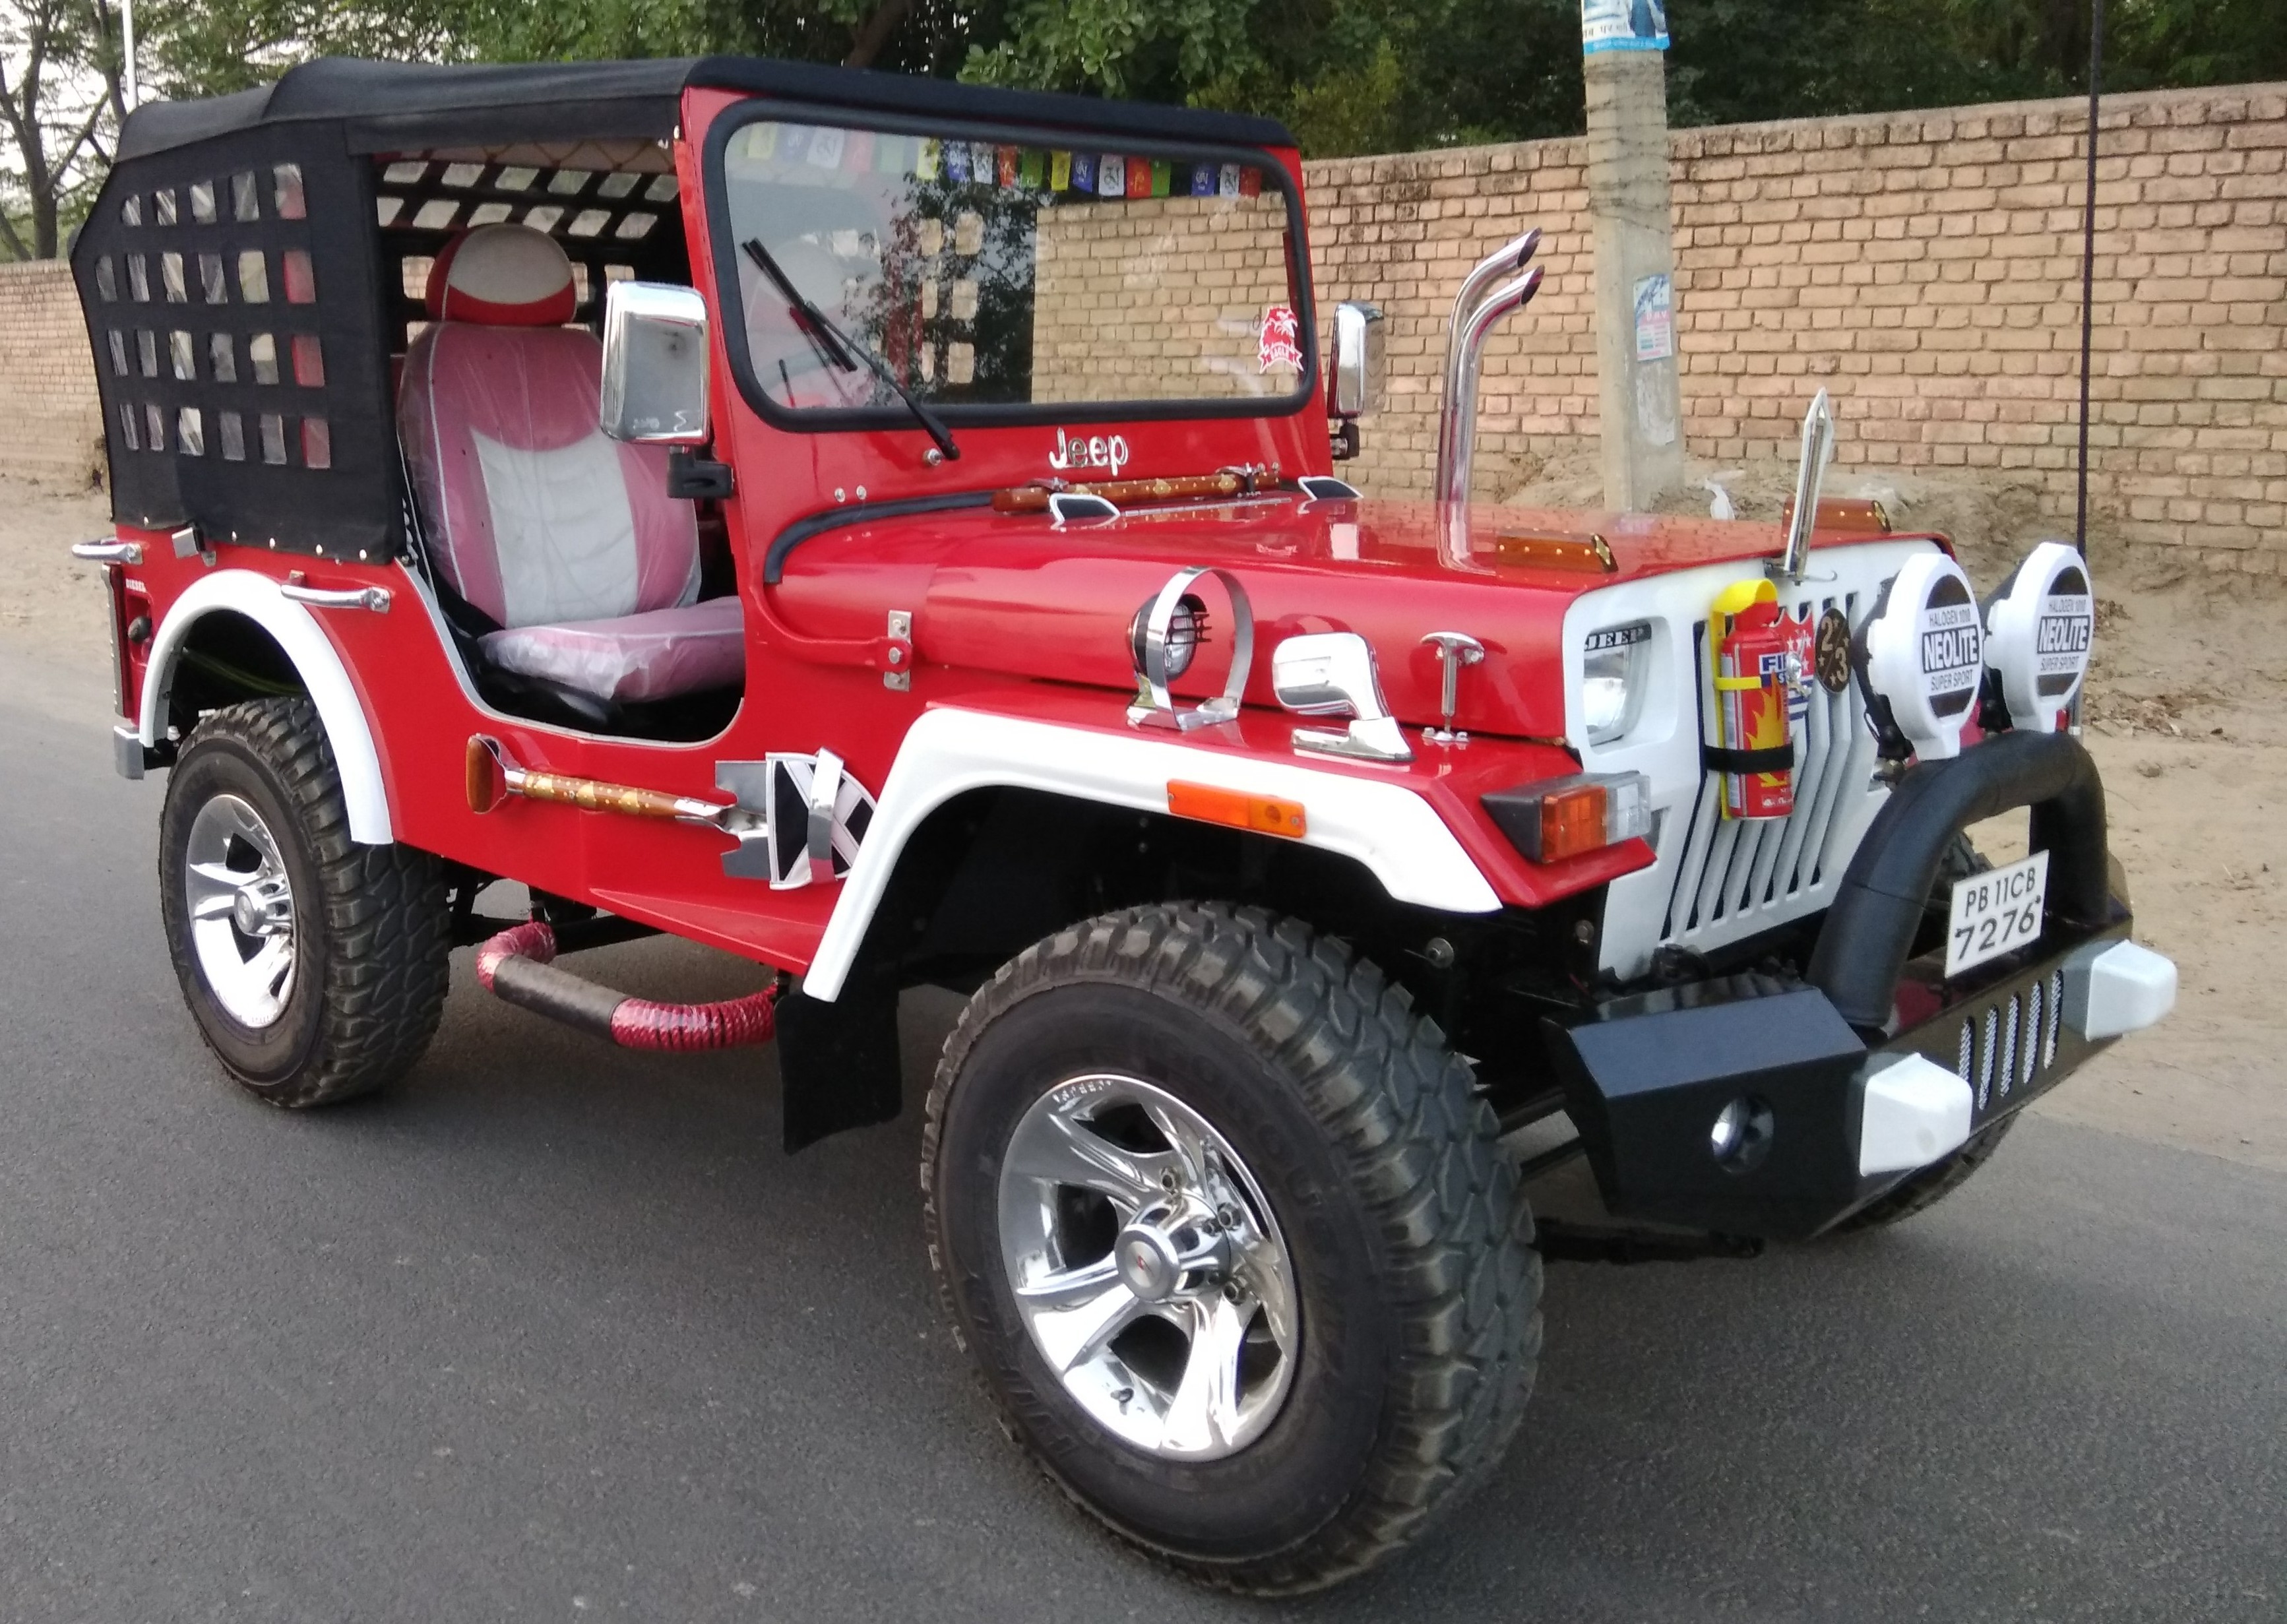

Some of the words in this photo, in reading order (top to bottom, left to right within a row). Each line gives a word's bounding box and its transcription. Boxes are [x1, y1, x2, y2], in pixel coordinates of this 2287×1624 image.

[1049, 426, 1128, 476] Jeep
[1929, 609, 1958, 627] HALOGEN
[2038, 617, 2089, 652] NEOLITE
[1584, 628, 1645, 650] JEEP
[1924, 627, 1978, 671] NEOLITE
[1931, 672, 1952, 691] SUPER
[1953, 668, 1972, 687] SPORT
[2041, 657, 2059, 671] SUPER
[2059, 656, 2079, 669] SPORT
[1965, 886, 1989, 918] PB
[1995, 867, 2036, 906] 11CB
[1955, 900, 2036, 960] 7276
